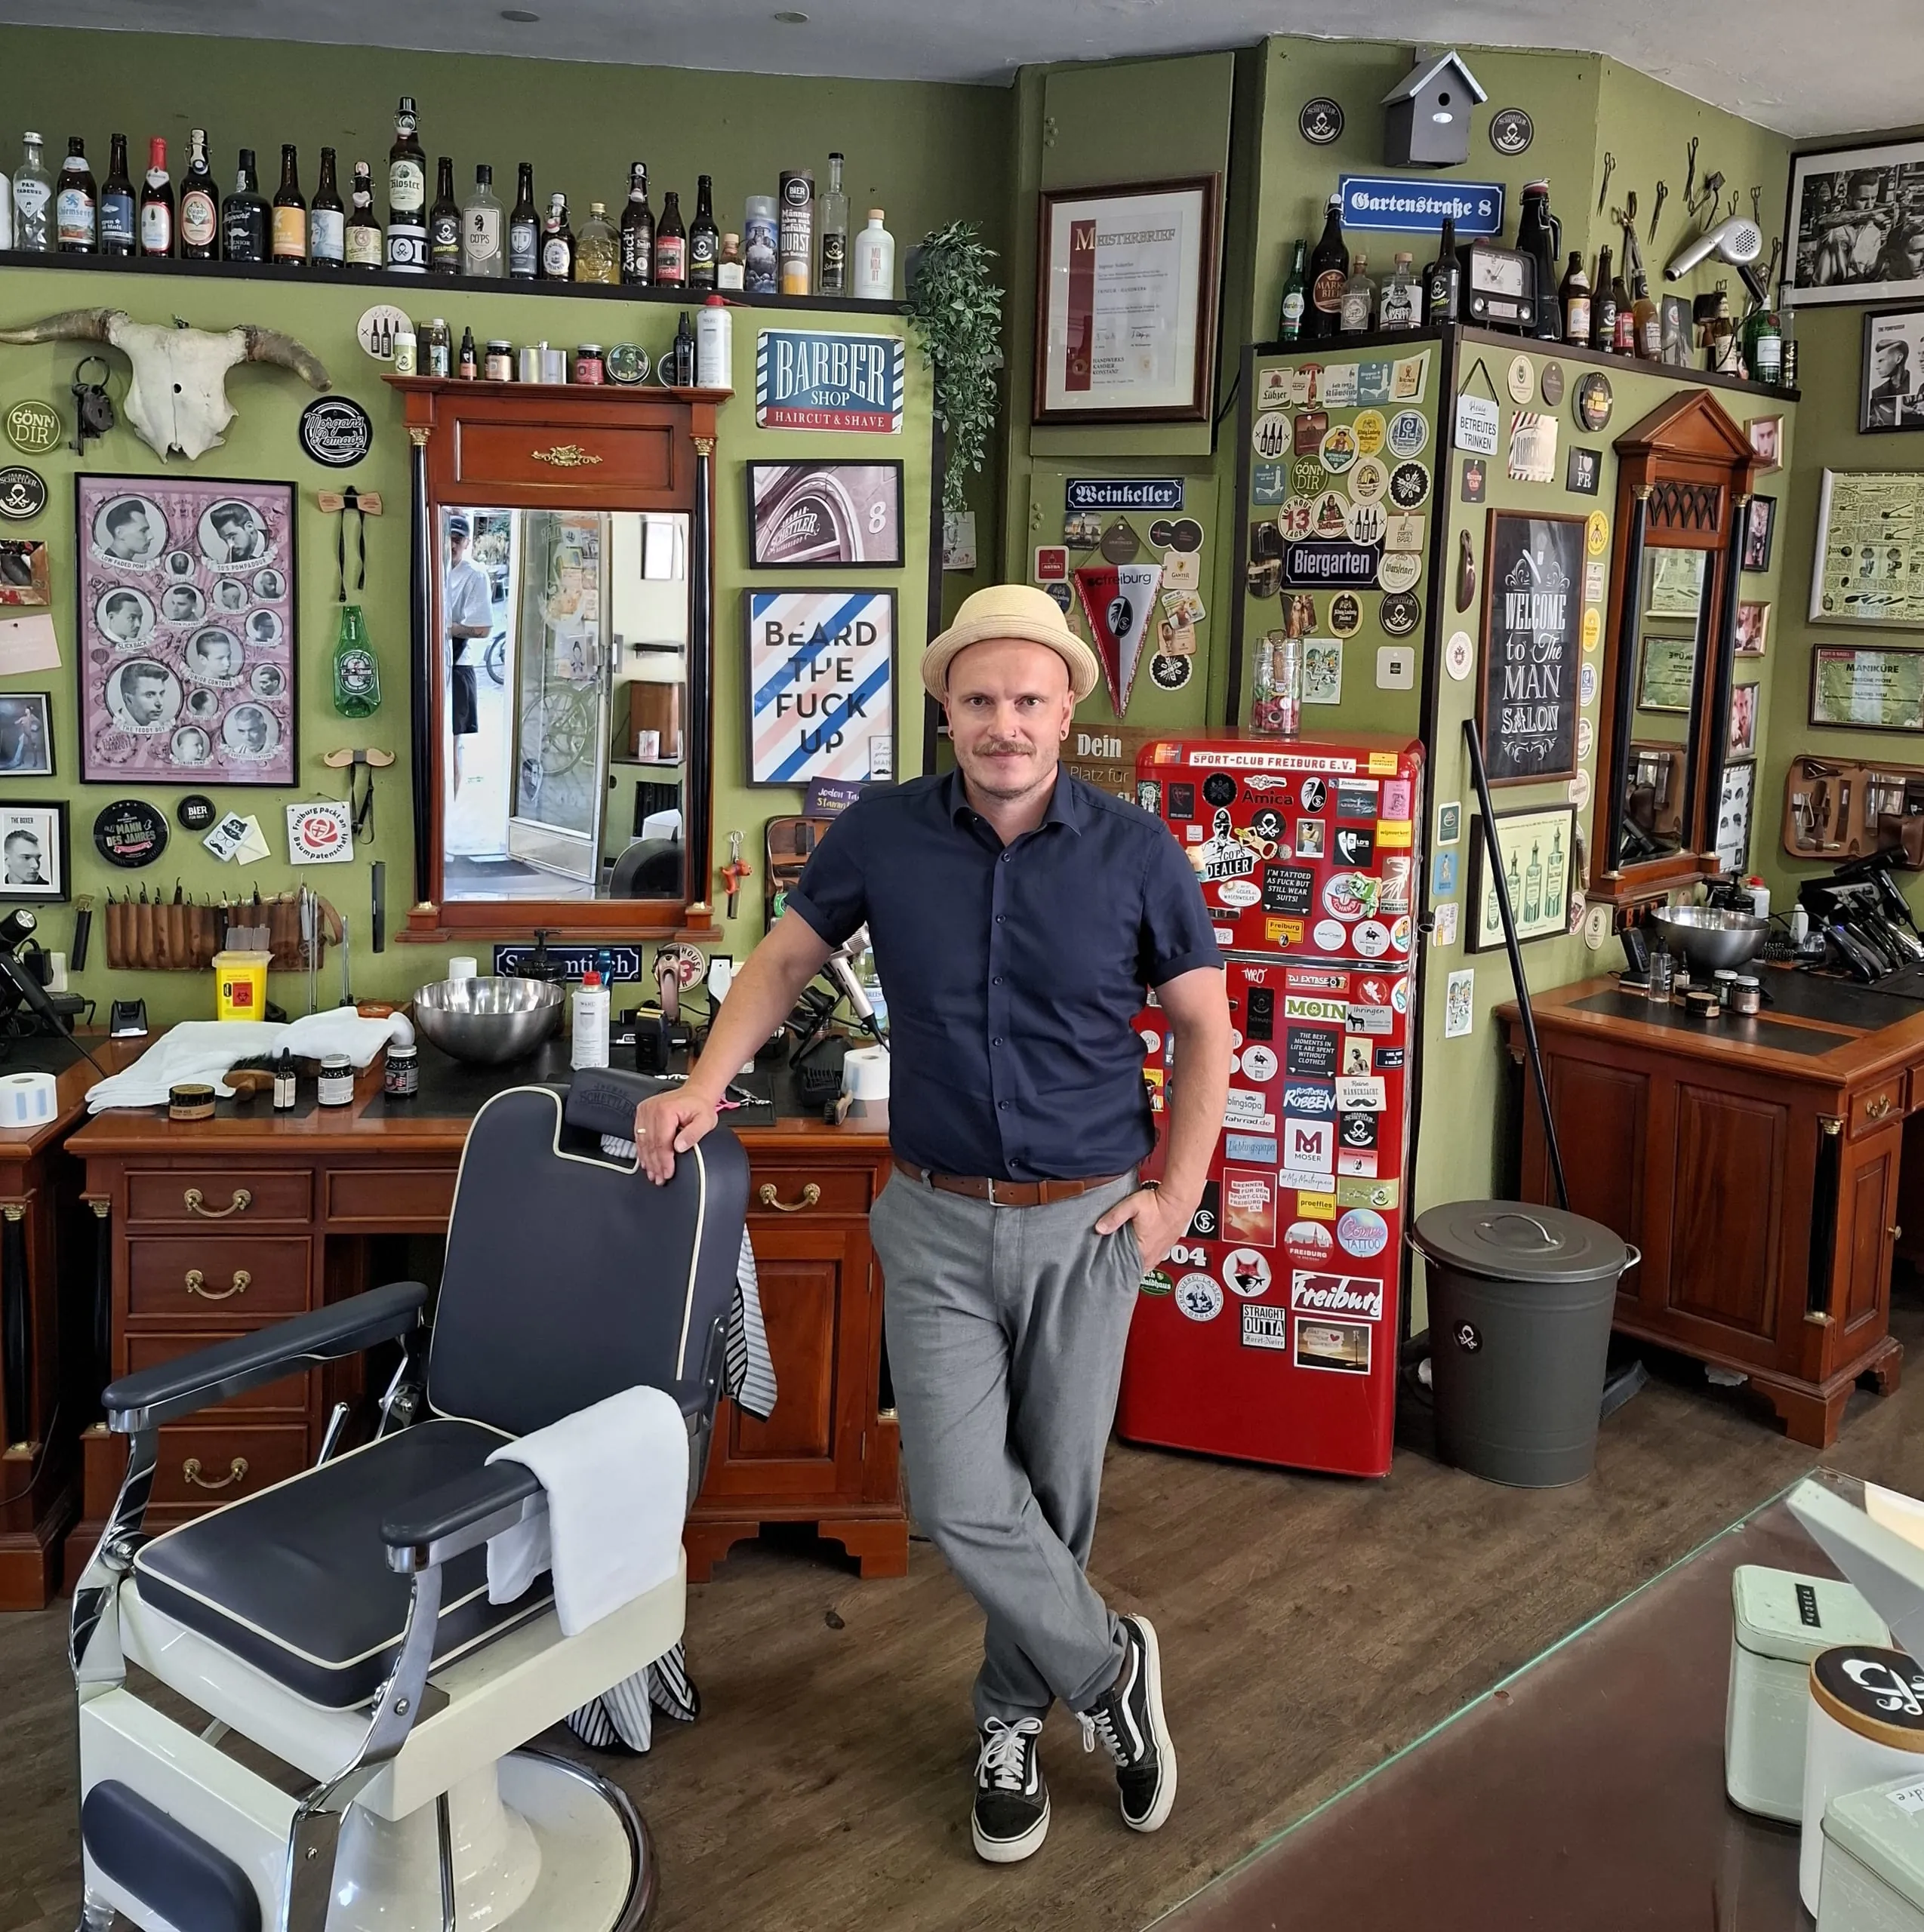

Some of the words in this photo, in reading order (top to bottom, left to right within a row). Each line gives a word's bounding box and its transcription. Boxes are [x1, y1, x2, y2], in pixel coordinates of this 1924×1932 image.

[782, 210, 810, 219] Männer
[1351, 192, 1472, 219] Gartenstraße
[1478, 199, 1492, 217] 8
[782, 223, 810, 232] Gefühle
[782, 234, 810, 251] DURST
[1075, 227, 1176, 251] MEISTERBRIEF
[775, 340, 885, 406] BARBER
[811, 389, 850, 407] SHOP
[1263, 390, 1287, 399] Lübzer
[12, 410, 54, 427] GÖNN
[304, 412, 365, 437] Morgan's
[776, 411, 830, 425] HAIRCUT
[833, 414, 841, 425] &
[845, 415, 885, 428] SHAVE
[1461, 417, 1496, 435] BETREUTES
[15, 424, 49, 445] DIR
[311, 429, 364, 448] Pomade
[1464, 433, 1491, 450] TRINKEN
[1295, 463, 1324, 476] GÖNN
[1297, 475, 1319, 489] DIR
[1577, 472, 1591, 488] FR
[1076, 485, 1173, 503] Weinkeller
[868, 501, 886, 534] 8
[1282, 503, 1291, 519] HOP
[1294, 500, 1312, 511] HOUS
[1288, 509, 1310, 531] 13
[231, 557, 266, 571] POMPADOUR
[1294, 549, 1370, 577] Biergarten
[1505, 592, 1566, 629] WELCOME
[765, 621, 877, 646] BEARD
[1507, 632, 1525, 661] to
[788, 657, 854, 682] THE
[1846, 663, 1899, 672] MANIKÜRE
[1503, 663, 1562, 701] MAN
[777, 693, 867, 718] FUCK
[1501, 705, 1559, 734] SALON
[801, 729, 843, 754] UP
[1077, 734, 1122, 758] Dein
[1193, 755, 1264, 766] SPORT-CLUB
[1267, 757, 1325, 769] FREIBURG
[1329, 760, 1353, 771] E.V.
[1070, 766, 1104, 781] Platz
[1109, 768, 1129, 783] für
[1241, 790, 1293, 805] Amica
[189, 806, 207, 815] BIER
[293, 807, 318, 830] Freiburg
[319, 807, 340, 822] packt
[339, 820, 346, 829] an
[116, 821, 142, 834] MANN
[106, 835, 122, 847] DES
[125, 830, 156, 844] JAHRES
[293, 833, 348, 860] Baumpatenschaft
[1207, 859, 1248, 878] DEALER
[1280, 871, 1311, 879] TATTOED
[1270, 922, 1300, 931] Freiburg
[506, 955, 628, 974] Smtich
[681, 946, 701, 974] HOUSE
[1287, 999, 1346, 1020] MOIN
[1353, 1007, 1385, 1016] Ihringen
[1227, 1094, 1262, 1111] blingsopa
[1283, 1089, 1337, 1111] ROBBEN
[1225, 1115, 1270, 1126] fahrrad.de
[1229, 1141, 1276, 1155] Lieblingspapa
[1294, 1153, 1321, 1161] MOSER
[1290, 1247, 1327, 1258] FREIBURG
[1345, 1238, 1381, 1249] TATTOO
[1162, 1244, 1207, 1266] 04
[1294, 1273, 1381, 1315] Freiburg
[1245, 1306, 1283, 1318] STRAIGHT
[1245, 1318, 1283, 1336] OUTTA
